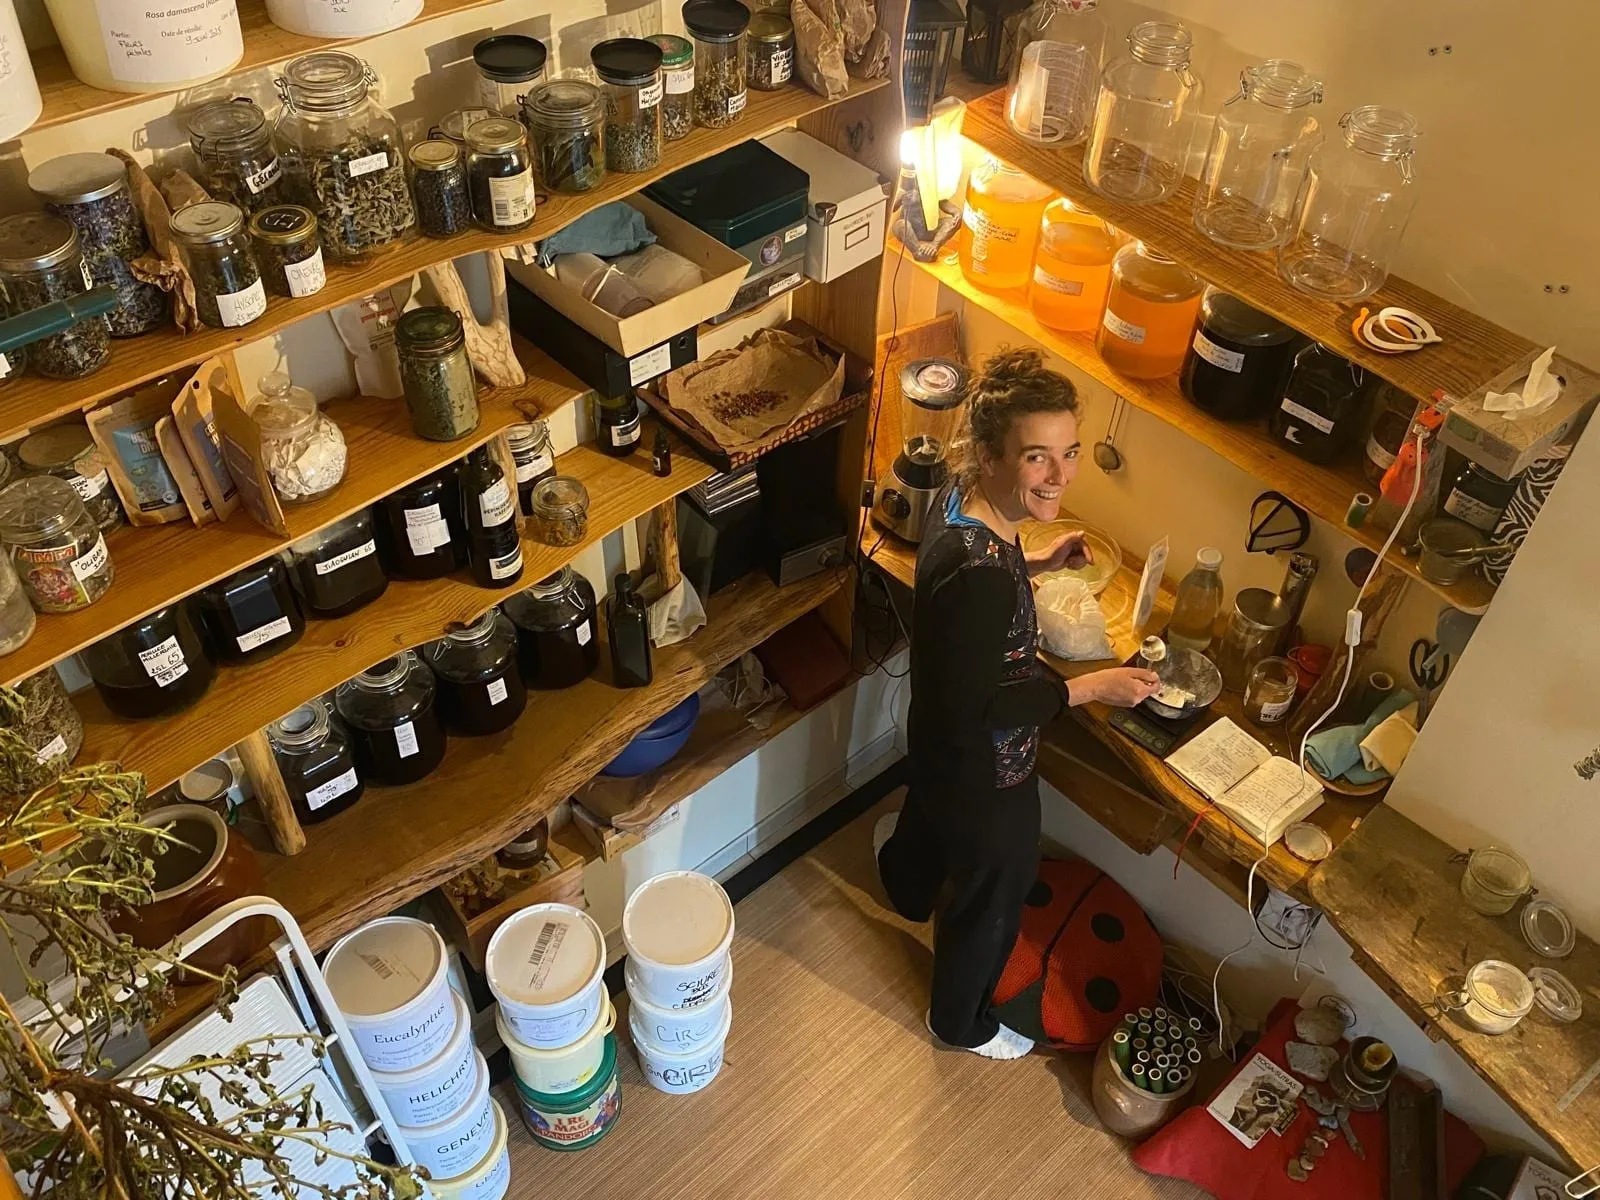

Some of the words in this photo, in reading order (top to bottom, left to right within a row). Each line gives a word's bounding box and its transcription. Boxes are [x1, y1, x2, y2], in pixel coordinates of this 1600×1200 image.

[145, 10, 165, 19] Rosa
[166, 2, 205, 17] damascena
[374, 1003, 445, 1044] Eucalyptus
